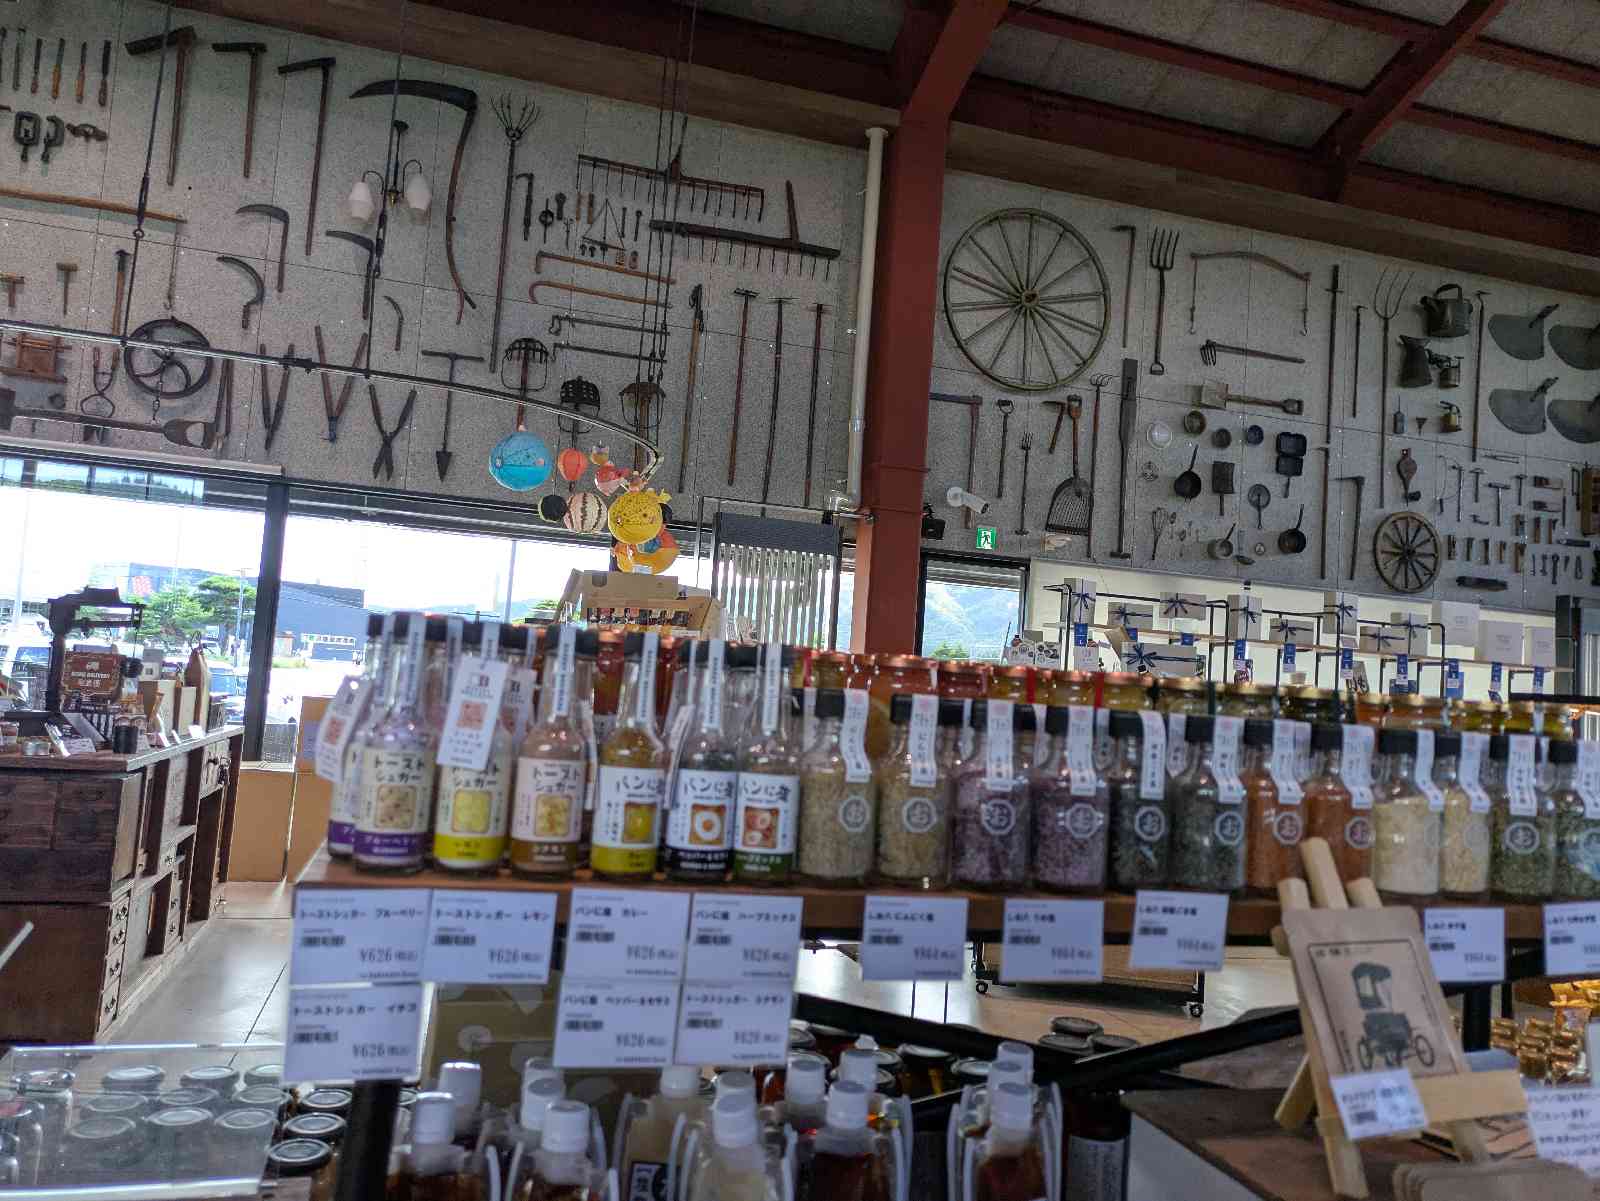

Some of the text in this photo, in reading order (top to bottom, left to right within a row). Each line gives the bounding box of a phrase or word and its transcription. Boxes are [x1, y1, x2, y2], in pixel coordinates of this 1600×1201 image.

[374, 756, 425, 771] トースト
[375, 771, 422, 783] シュガー
[533, 767, 580, 780] トースト
[452, 775, 498, 789] シュガー
[535, 780, 577, 792] シュガー
[299, 908, 425, 921] トーストシュガー ブルーベリー
